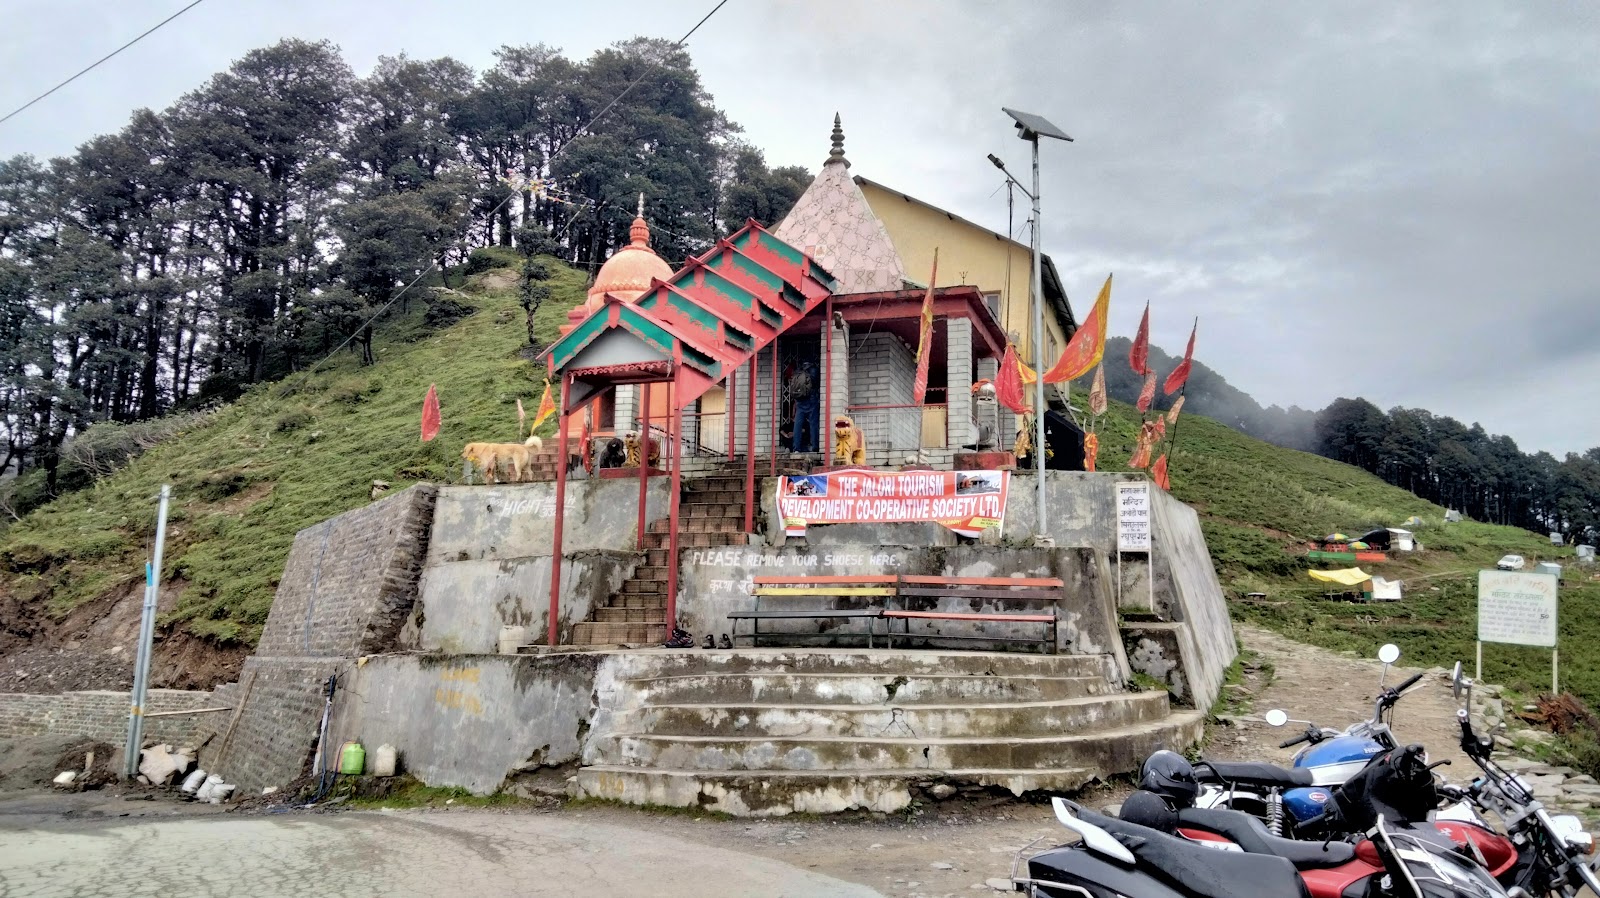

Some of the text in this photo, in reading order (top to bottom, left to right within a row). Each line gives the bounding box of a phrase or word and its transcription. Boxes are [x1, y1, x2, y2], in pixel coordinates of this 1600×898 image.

[838, 475, 944, 497] THE JALORI TOURISM
[499, 500, 544, 519] HIGHT
[781, 495, 1002, 520] DEVELOPMENT CO-OPERATIVE SOCIETY LTD.
[693, 551, 901, 567] PLEASE REMOVE YOUR SHOESE HERE.
